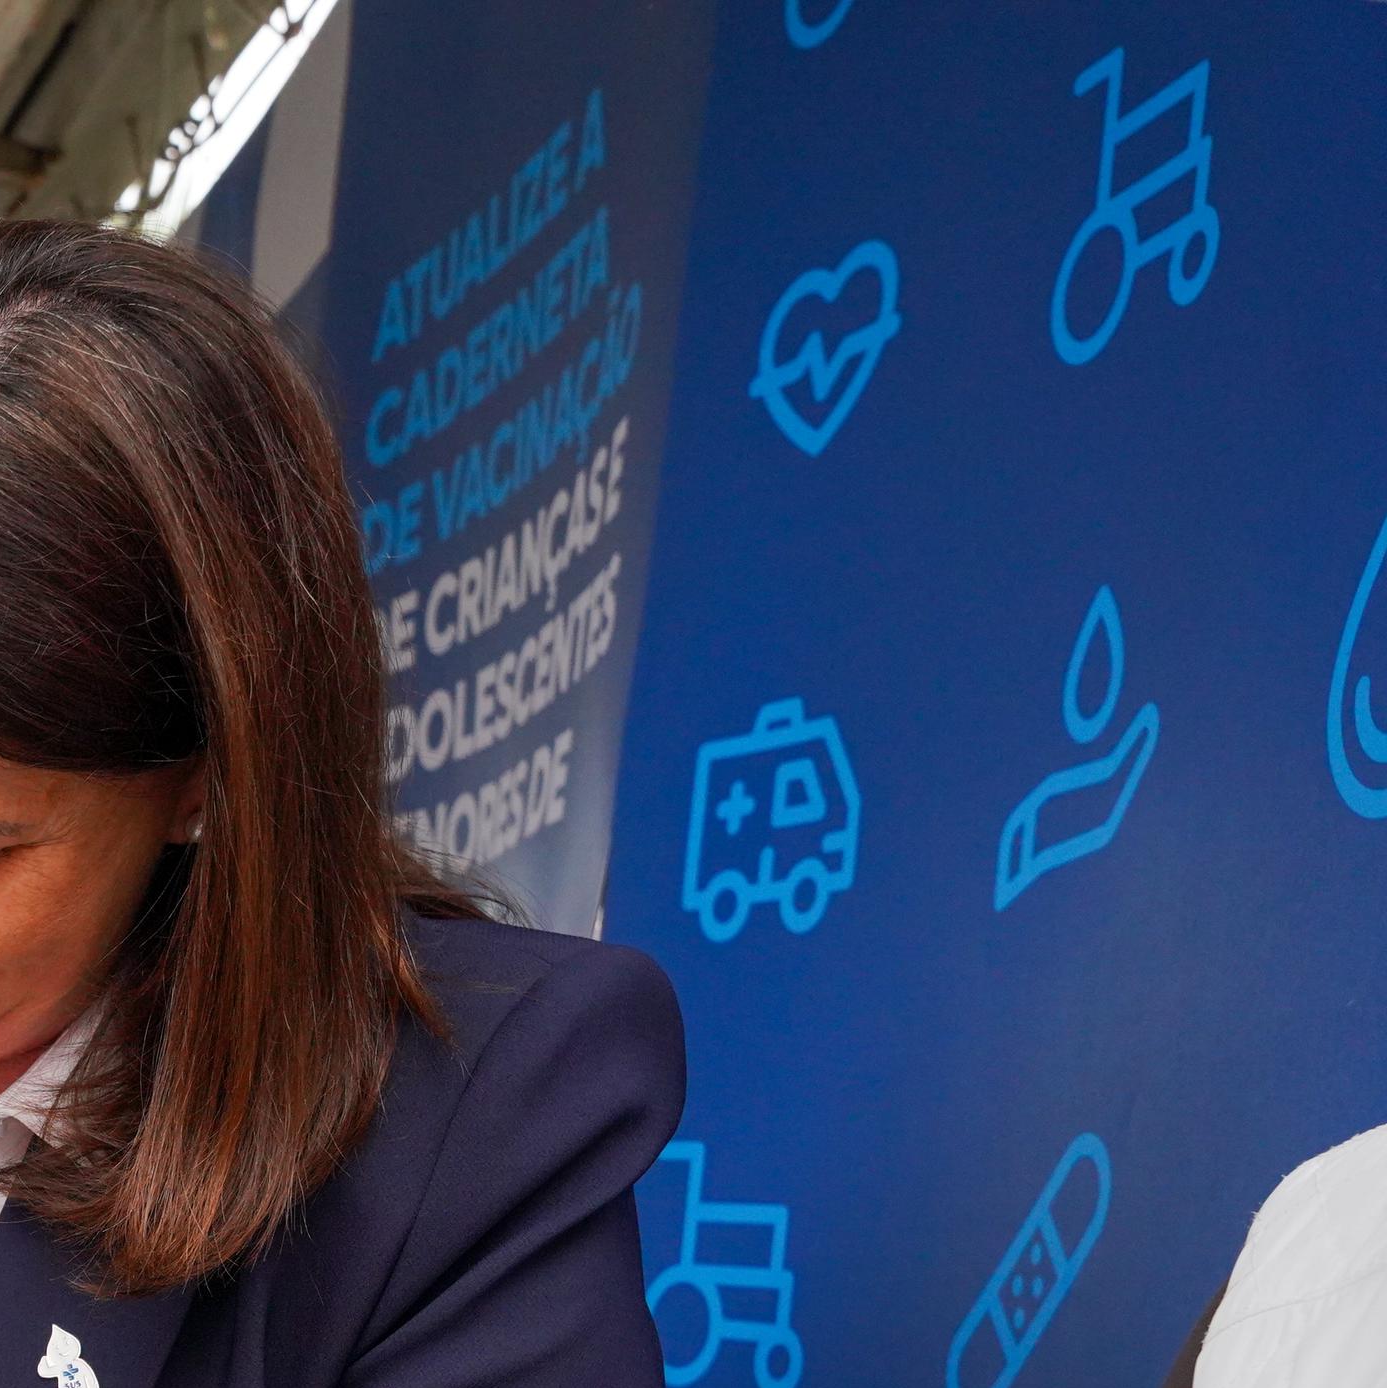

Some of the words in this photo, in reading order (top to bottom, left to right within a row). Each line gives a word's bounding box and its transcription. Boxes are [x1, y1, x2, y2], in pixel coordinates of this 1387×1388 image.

[365, 203, 609, 468] CADERNETA
[372, 121, 572, 363] ATUALIZE
[575, 88, 606, 193] A
[362, 481, 424, 576] DE
[431, 280, 642, 541] VACINAÇÃO
[424, 447, 607, 656] CRIANÇAS
[384, 552, 622, 786] DOLESCENTES
[524, 728, 574, 840] DE
